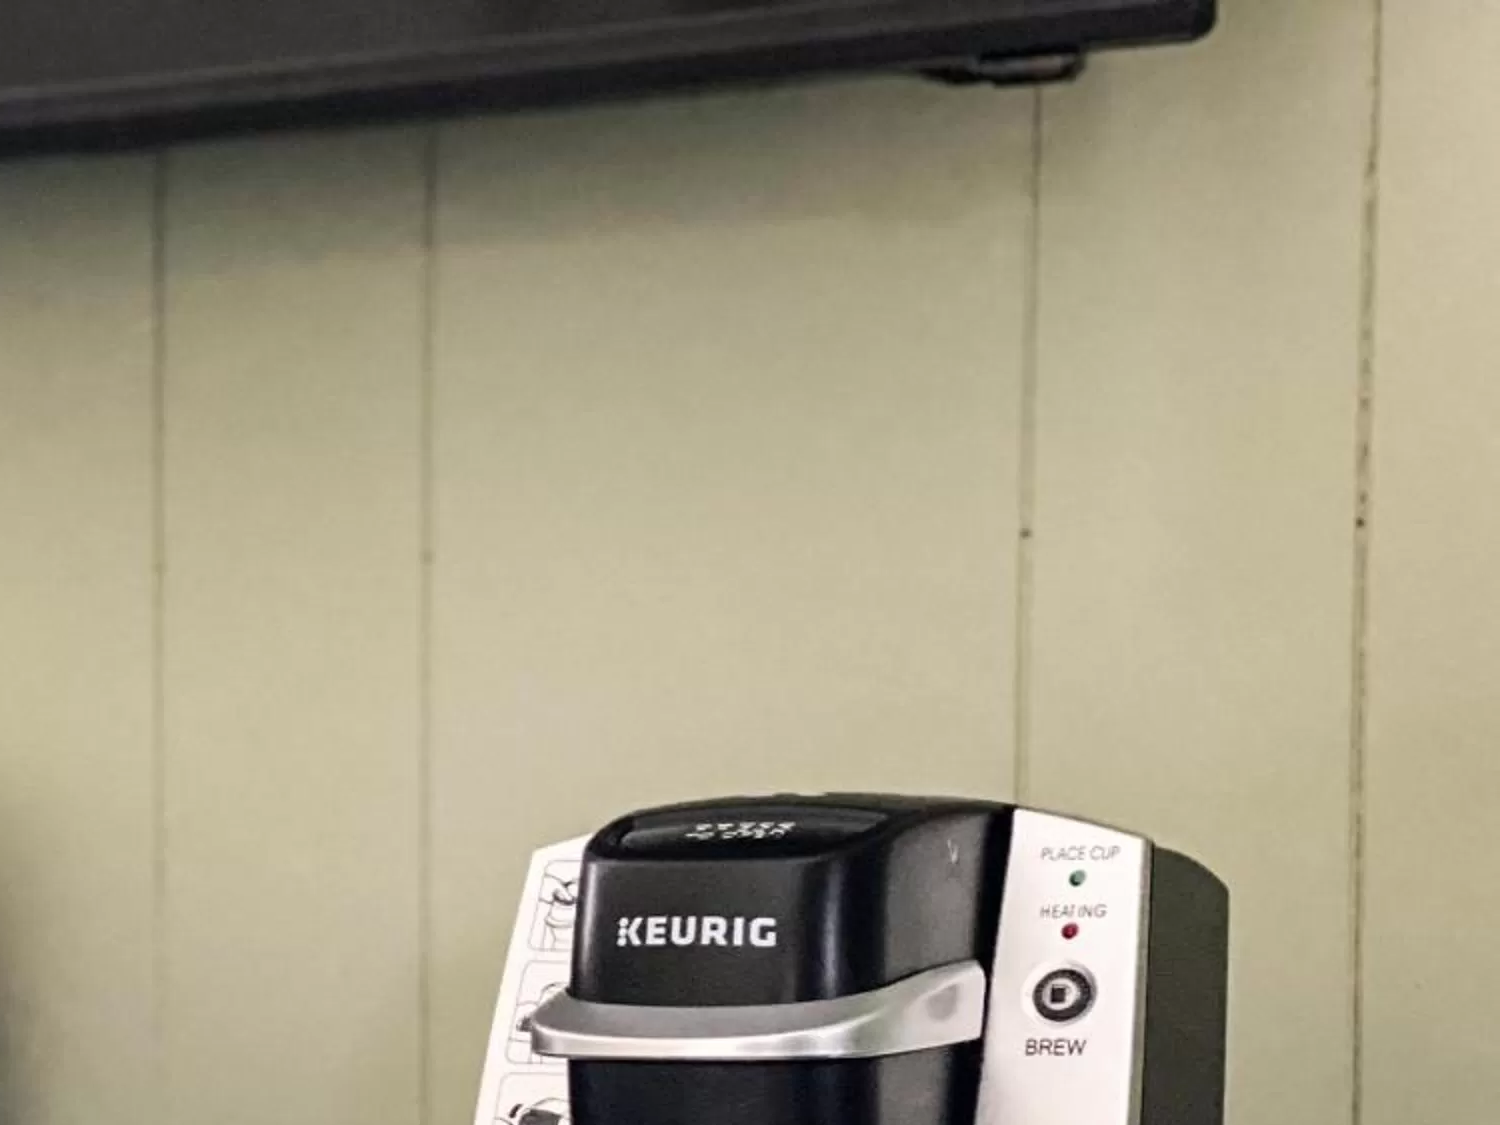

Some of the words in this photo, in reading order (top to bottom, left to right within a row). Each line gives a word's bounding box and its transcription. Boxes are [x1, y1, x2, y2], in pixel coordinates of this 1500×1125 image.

[1041, 845, 1086, 861] PLACE
[1089, 845, 1121, 860] CUP
[1040, 904, 1108, 919] HEATING
[616, 915, 777, 947] KEURIG
[1025, 1038, 1087, 1056] BREW
